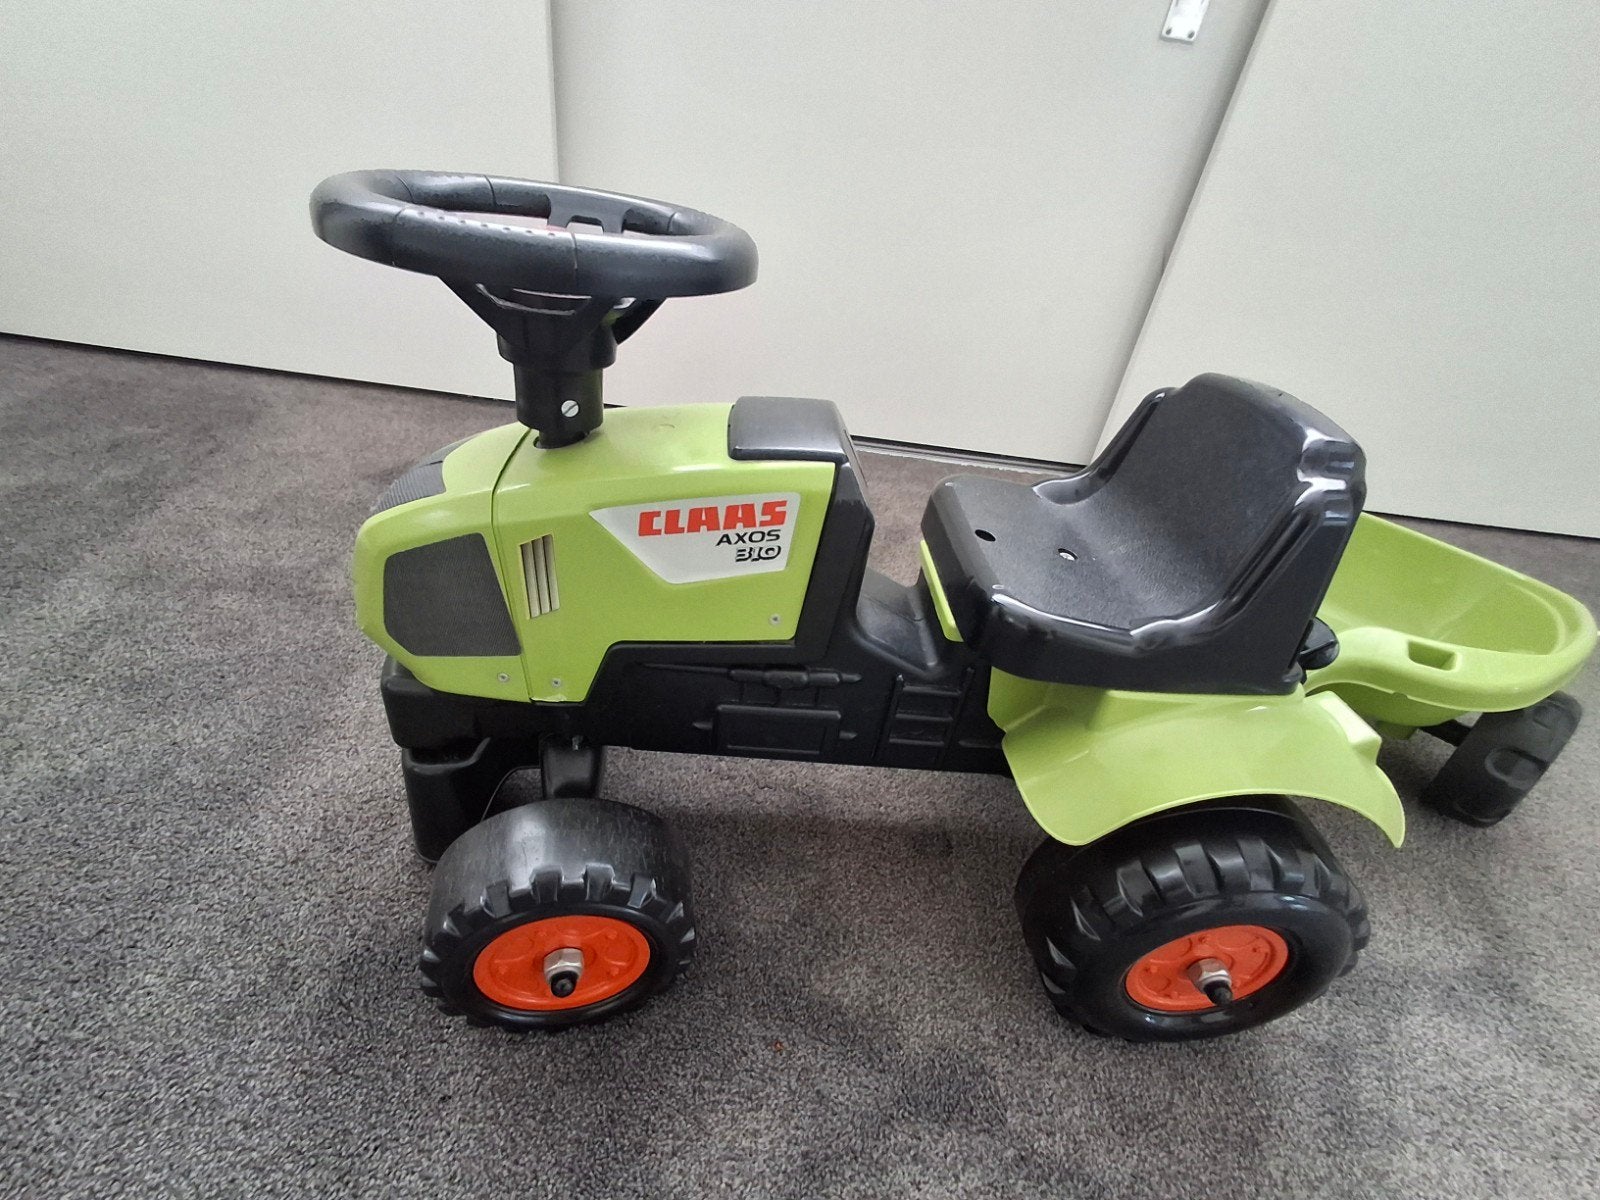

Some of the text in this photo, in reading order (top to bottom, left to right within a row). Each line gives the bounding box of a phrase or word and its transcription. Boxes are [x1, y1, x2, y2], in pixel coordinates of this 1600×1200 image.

[638, 500, 788, 537] CLAAS
[716, 529, 781, 546] AXOS
[735, 545, 782, 562] 310
